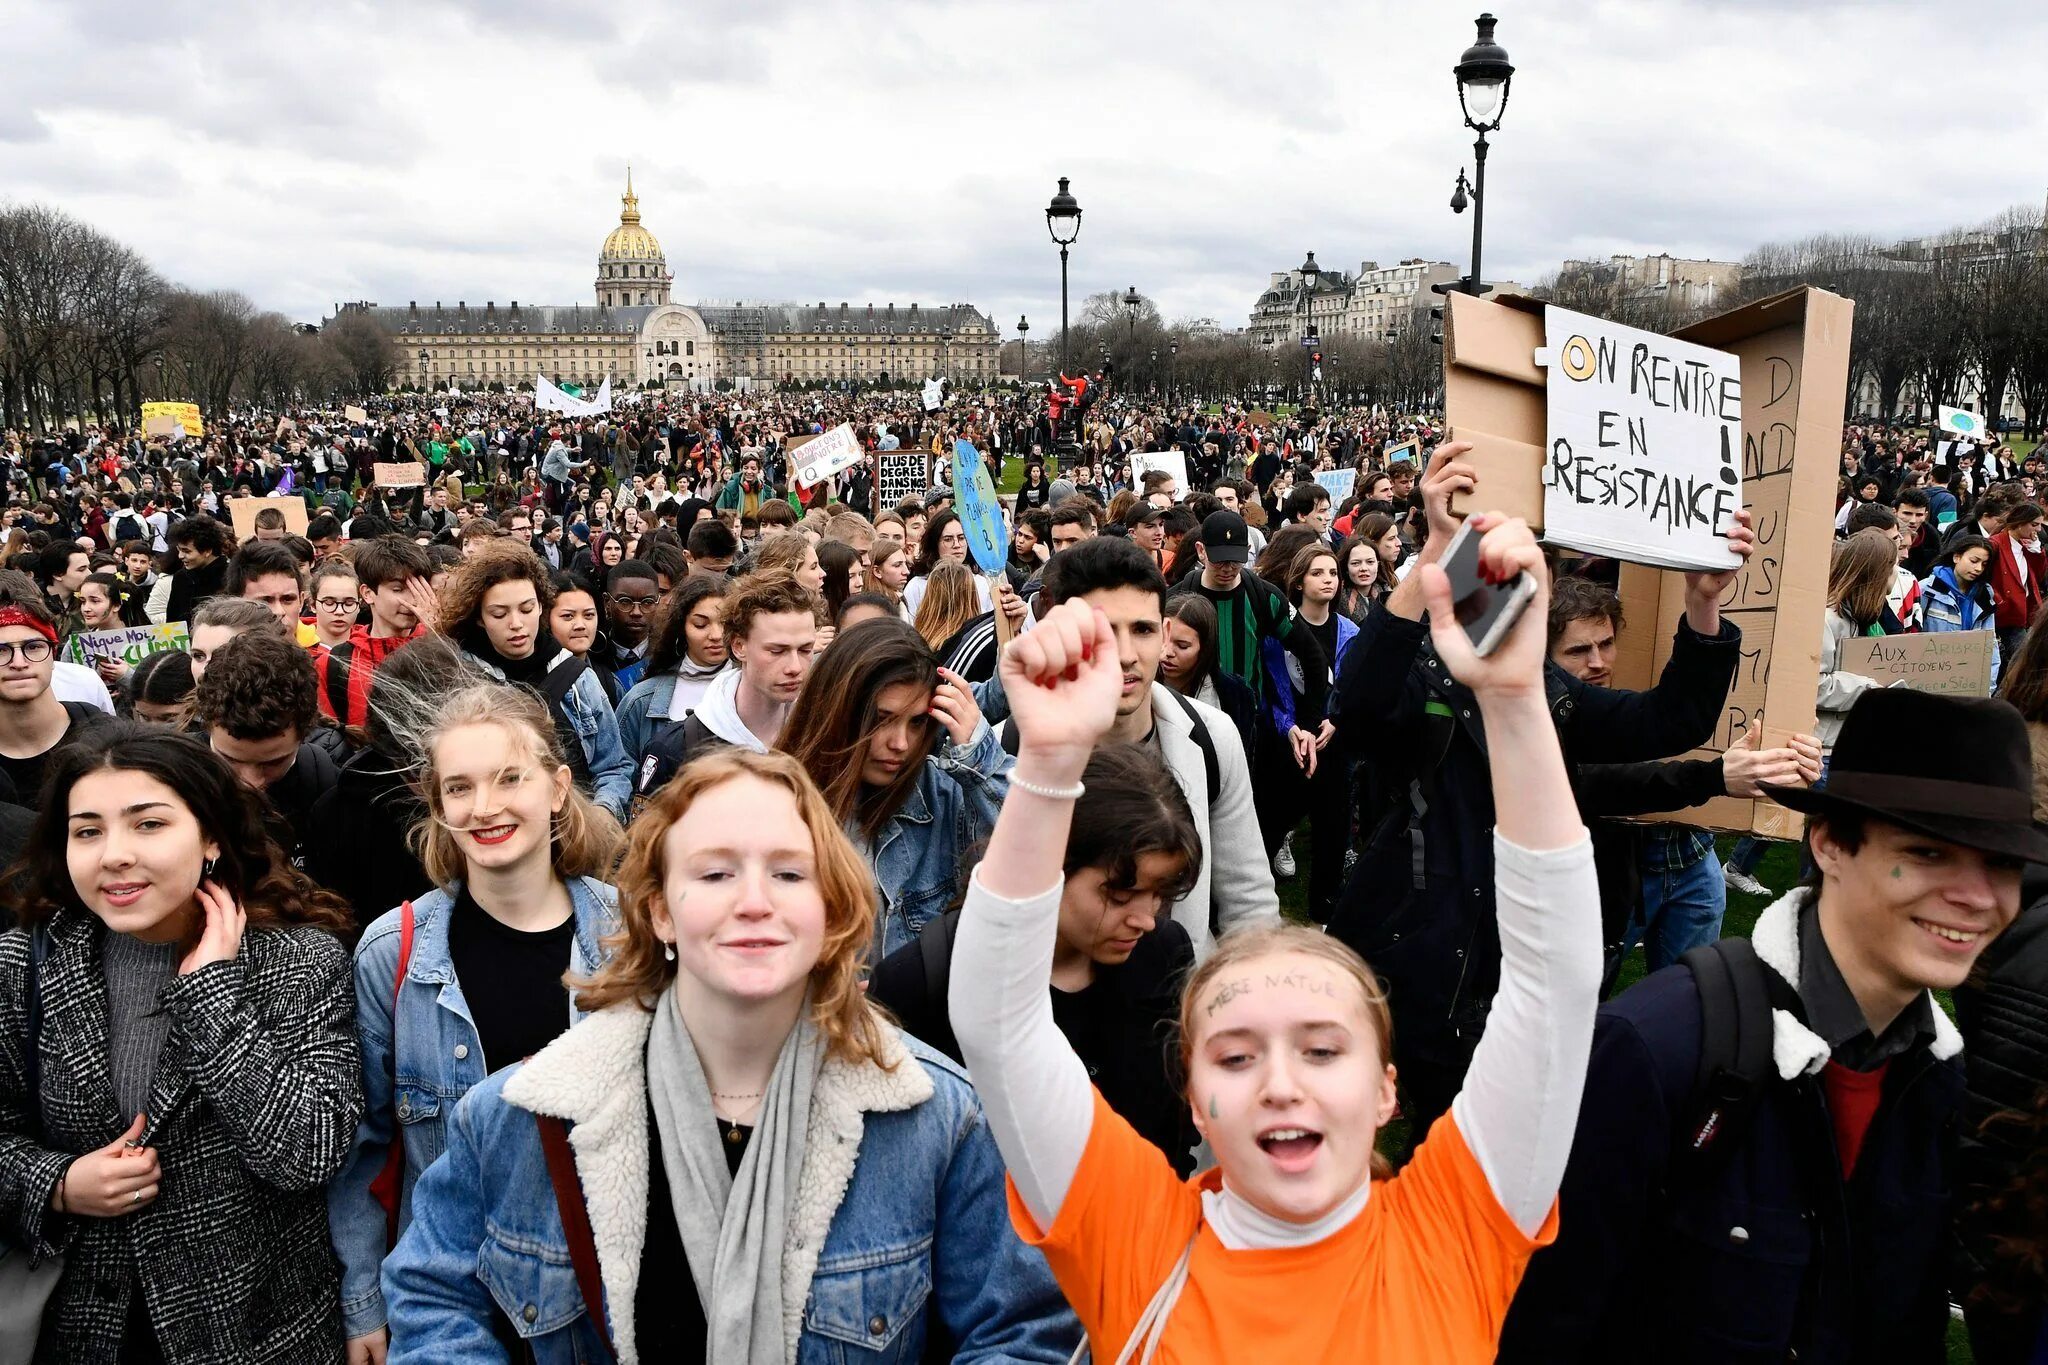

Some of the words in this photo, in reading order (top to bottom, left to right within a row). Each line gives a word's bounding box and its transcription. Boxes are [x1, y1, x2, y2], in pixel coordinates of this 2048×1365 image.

[1562, 334, 1616, 384] ON
[1630, 343, 1742, 422] RENTRE
[1599, 410, 1648, 456] EN
[880, 456, 908, 467] PLUS
[908, 455, 925, 466] DE
[880, 466, 925, 478] DEGRES
[880, 477, 910, 489] DANS
[910, 477, 927, 489] NOS
[1319, 472, 1353, 487] MAKE
[880, 500, 900, 510] MOI
[981, 529, 993, 551] B
[79, 634, 124, 654] Nique
[1889, 661, 1953, 674] CITOYENS
